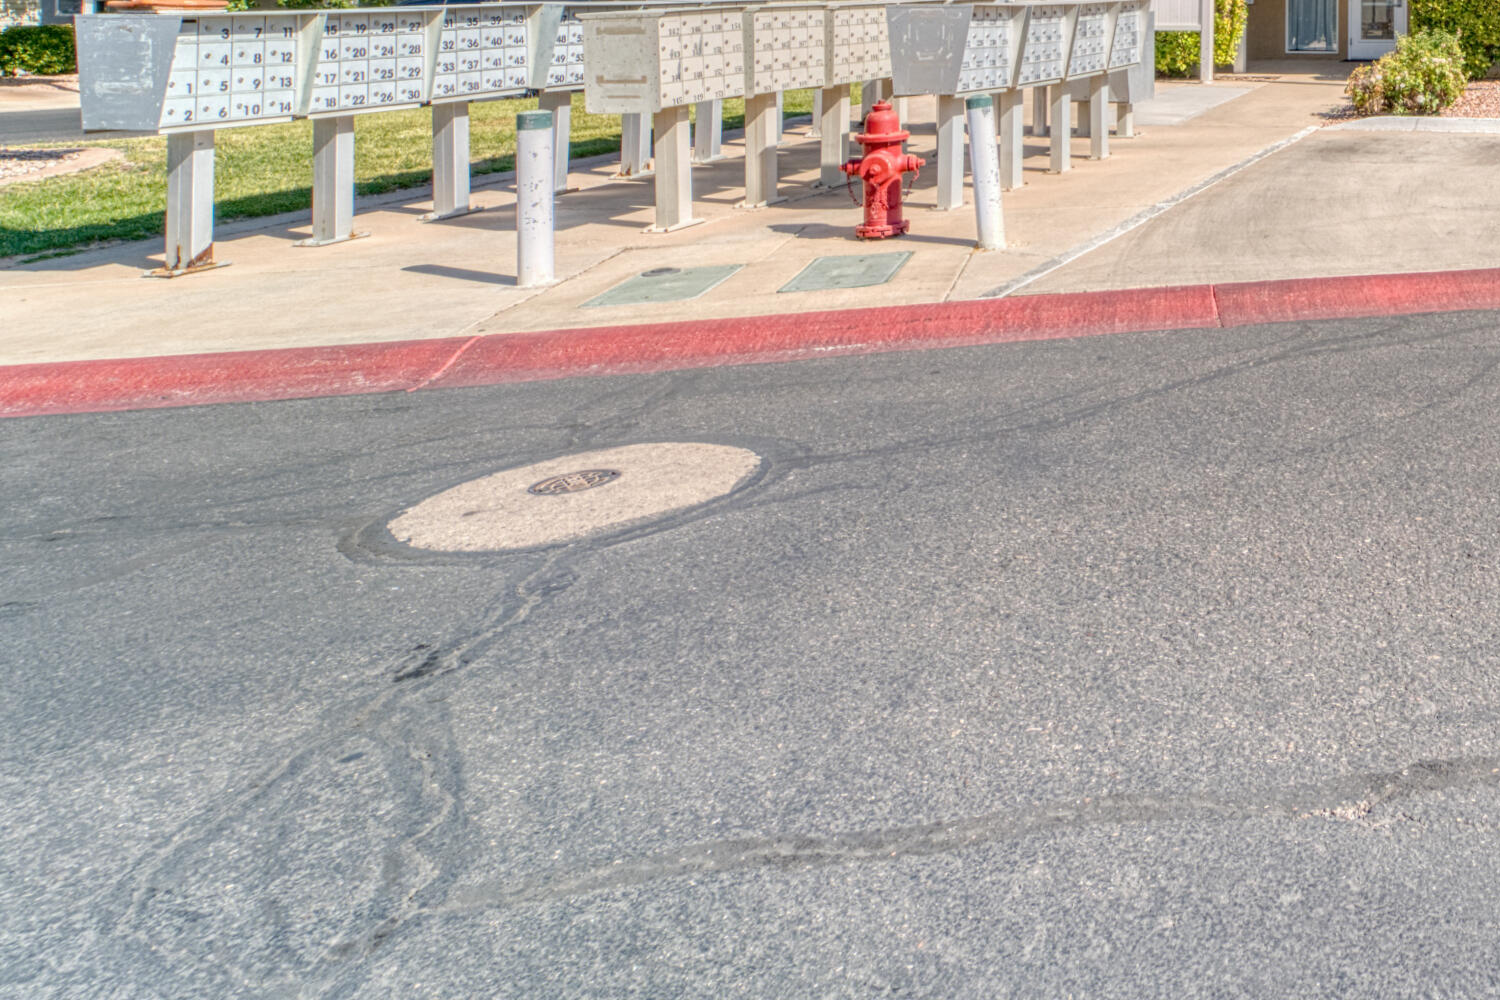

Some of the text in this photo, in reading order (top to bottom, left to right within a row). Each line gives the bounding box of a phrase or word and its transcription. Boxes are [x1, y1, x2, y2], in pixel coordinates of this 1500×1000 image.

[443, 18, 453, 28] 31
[466, 17, 478, 27] 35
[490, 15, 502, 25] 39
[325, 25, 338, 36] 15
[355, 23, 367, 33] 19
[381, 23, 394, 33] 23
[408, 22, 421, 32] 27
[221, 28, 230, 39] 3
[254, 27, 263, 38] 7
[282, 27, 293, 38] 11
[467, 38, 479, 48] 36
[491, 36, 503, 46] 40
[513, 34, 524, 44] 44
[556, 33, 567, 43] 48
[408, 44, 421, 55] 28
[442, 40, 454, 50] 32
[324, 48, 338, 59] 16
[352, 47, 366, 58] 20
[381, 46, 394, 56] 24
[220, 54, 229, 65] 4
[253, 53, 262, 64] 8
[281, 51, 293, 63] 12
[492, 57, 502, 67] 41
[514, 55, 525, 65] 45
[555, 54, 566, 63] 49
[442, 62, 455, 72] 33
[467, 59, 479, 69] 37
[352, 71, 365, 81] 21
[380, 69, 394, 79] 25
[408, 67, 421, 77] 29
[252, 78, 261, 89] 9
[280, 76, 292, 87] 13
[324, 73, 337, 84] 17
[491, 78, 503, 88] 42
[514, 76, 526, 86] 46
[554, 74, 565, 84] 50
[186, 83, 192, 94] 1
[219, 80, 228, 91] 5
[442, 84, 455, 94] 34
[467, 81, 479, 91] 38
[352, 94, 366, 105] 22
[380, 92, 393, 103] 26
[407, 90, 420, 100] 30
[279, 101, 291, 113] 14
[325, 97, 336, 108] 18
[218, 106, 227, 118] 6
[244, 104, 260, 115] 10
[184, 110, 193, 121] 2
